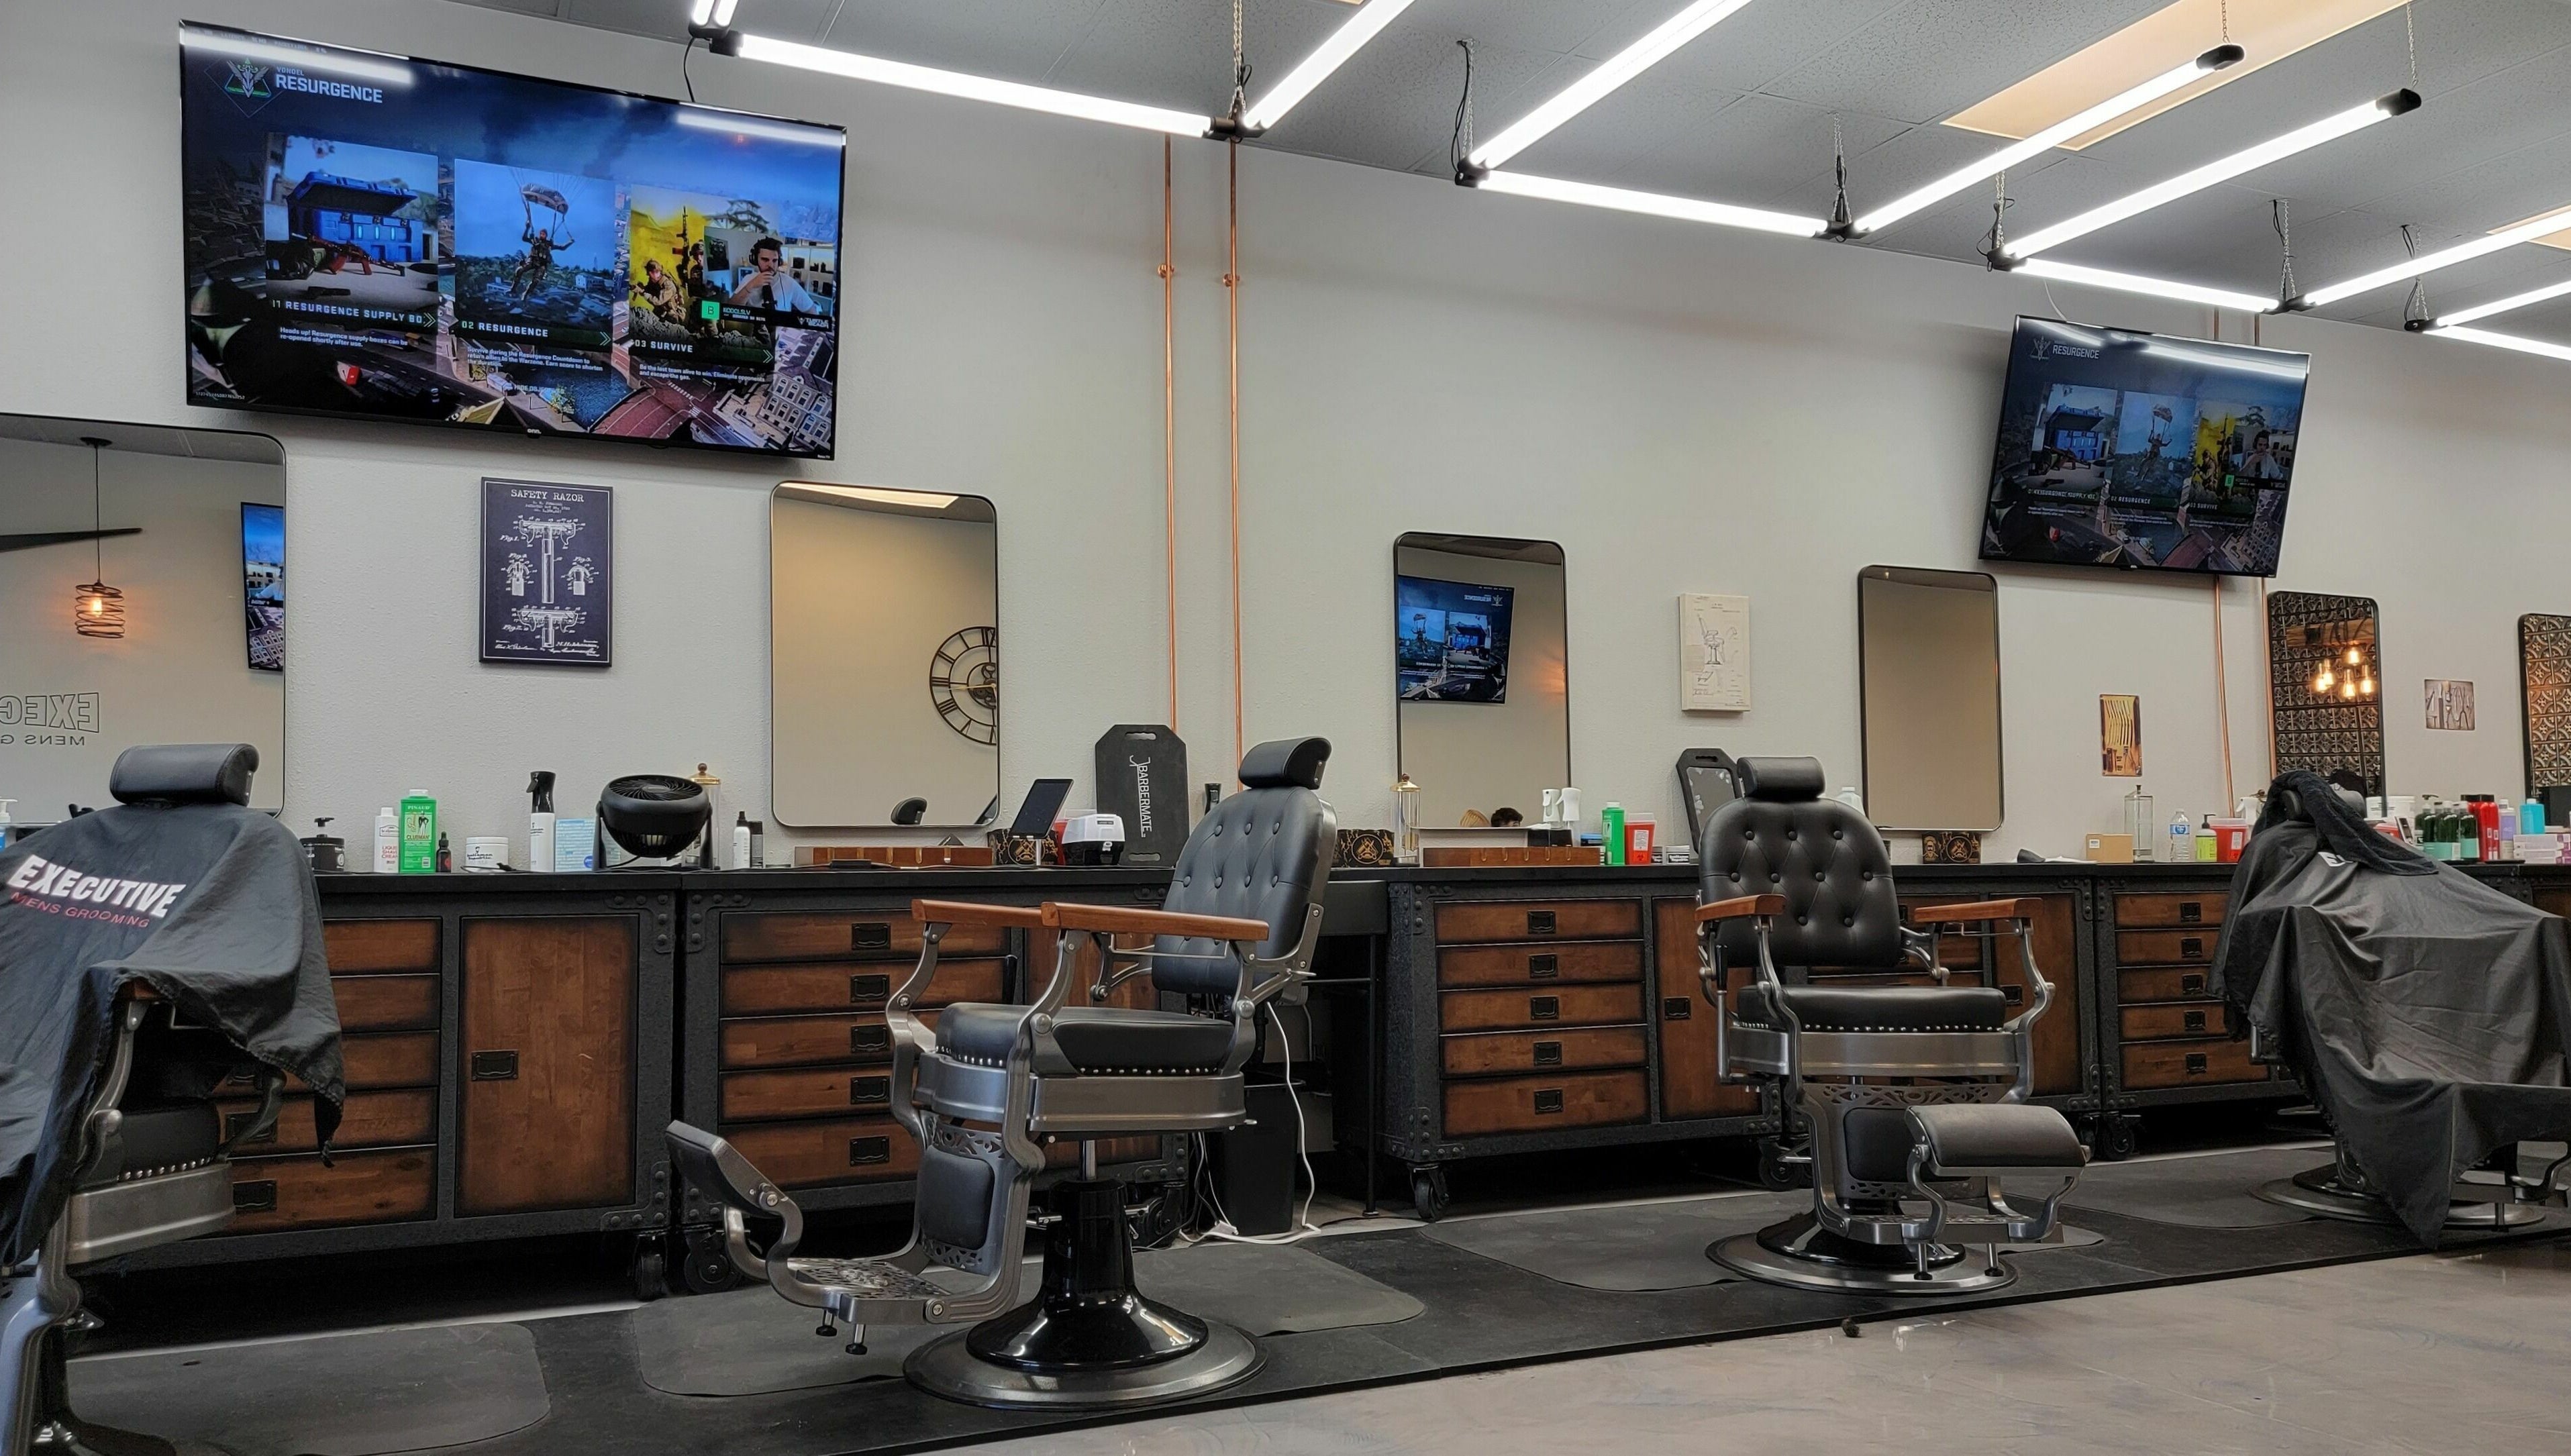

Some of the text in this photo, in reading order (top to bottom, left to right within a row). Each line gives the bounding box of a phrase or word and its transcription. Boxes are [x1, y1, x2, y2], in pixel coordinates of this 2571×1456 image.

[276, 74, 383, 103] RESURGENCE
[285, 301, 359, 317] RESURGENCE
[364, 309, 405, 321] SUPPLY
[311, 330, 347, 340] Resurgence
[462, 321, 548, 337] 02 RESURGENCE
[635, 339, 693, 353] 03 SURVIVE
[2053, 344, 2099, 359] RESURGENCE
[511, 488, 584, 502] SAFETY RAZOR
[1138, 765, 1152, 832] BARBERMATE
[7, 854, 187, 918] EXECUTIVE
[10, 892, 150, 928] MENS GROOMING
